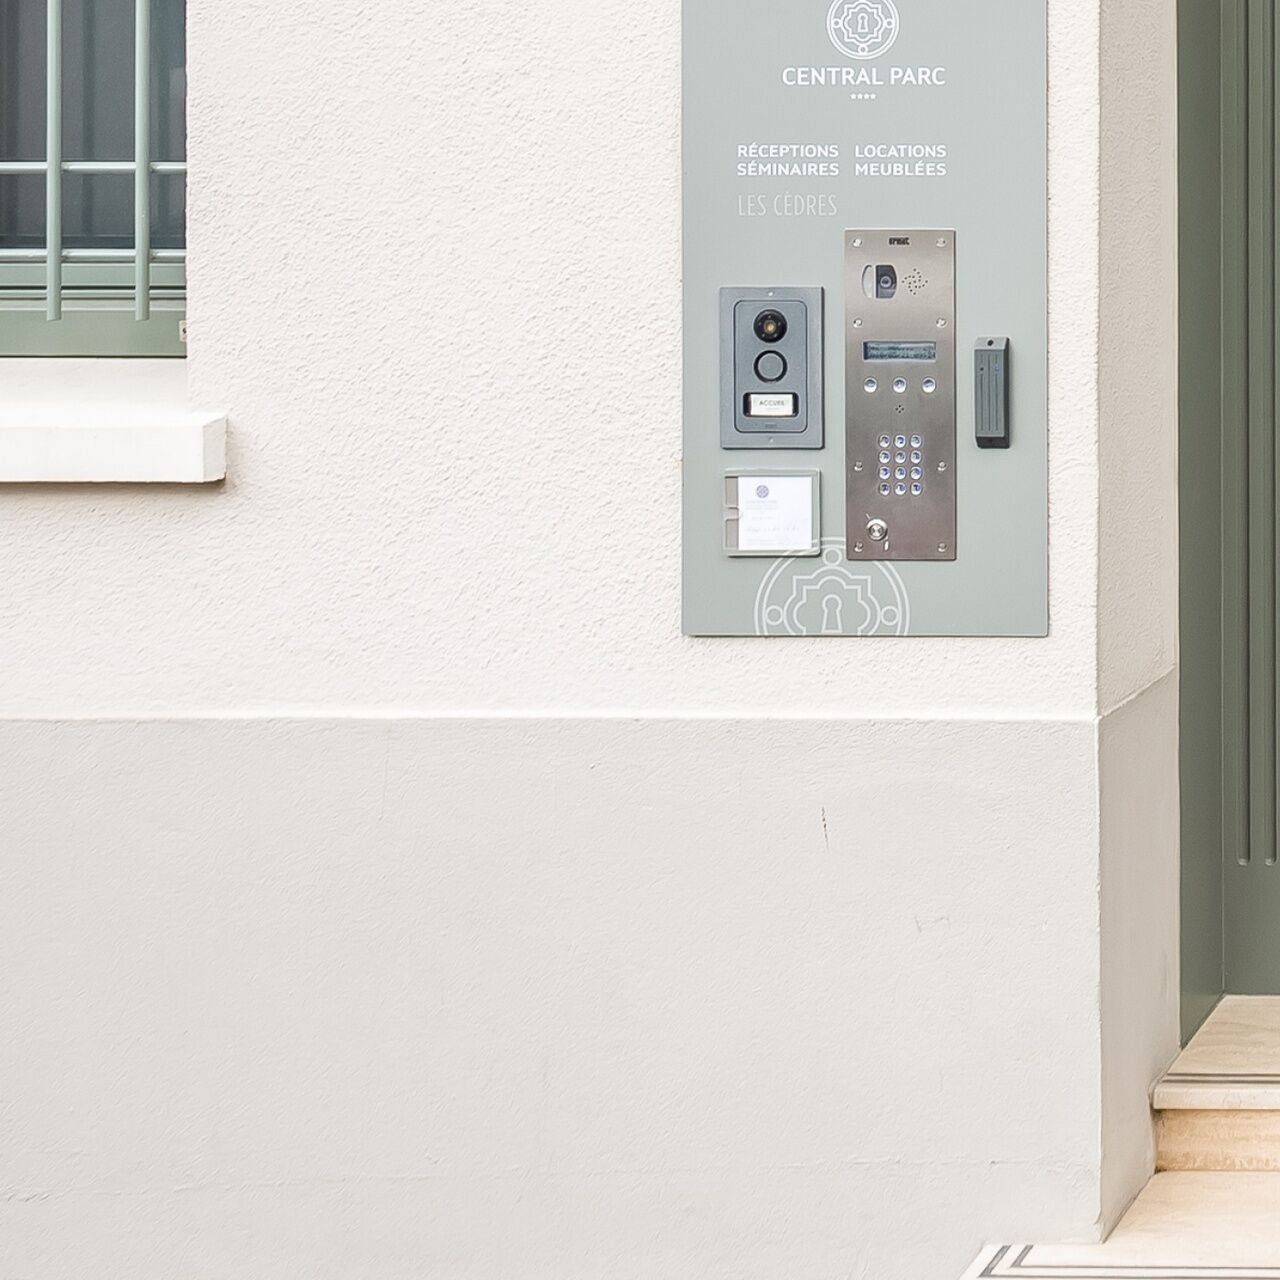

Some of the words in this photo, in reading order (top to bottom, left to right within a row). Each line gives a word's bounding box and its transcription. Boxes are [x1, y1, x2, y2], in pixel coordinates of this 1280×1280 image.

[782, 67, 884, 86] CENTRAL
[890, 67, 946, 86] PARC
[737, 141, 839, 158] RÉCEPTIONS
[855, 144, 947, 158] LOCATIONS
[737, 159, 839, 176] SÉMINAIRES
[855, 160, 947, 176] MEUBLÉES
[738, 194, 767, 216] LES
